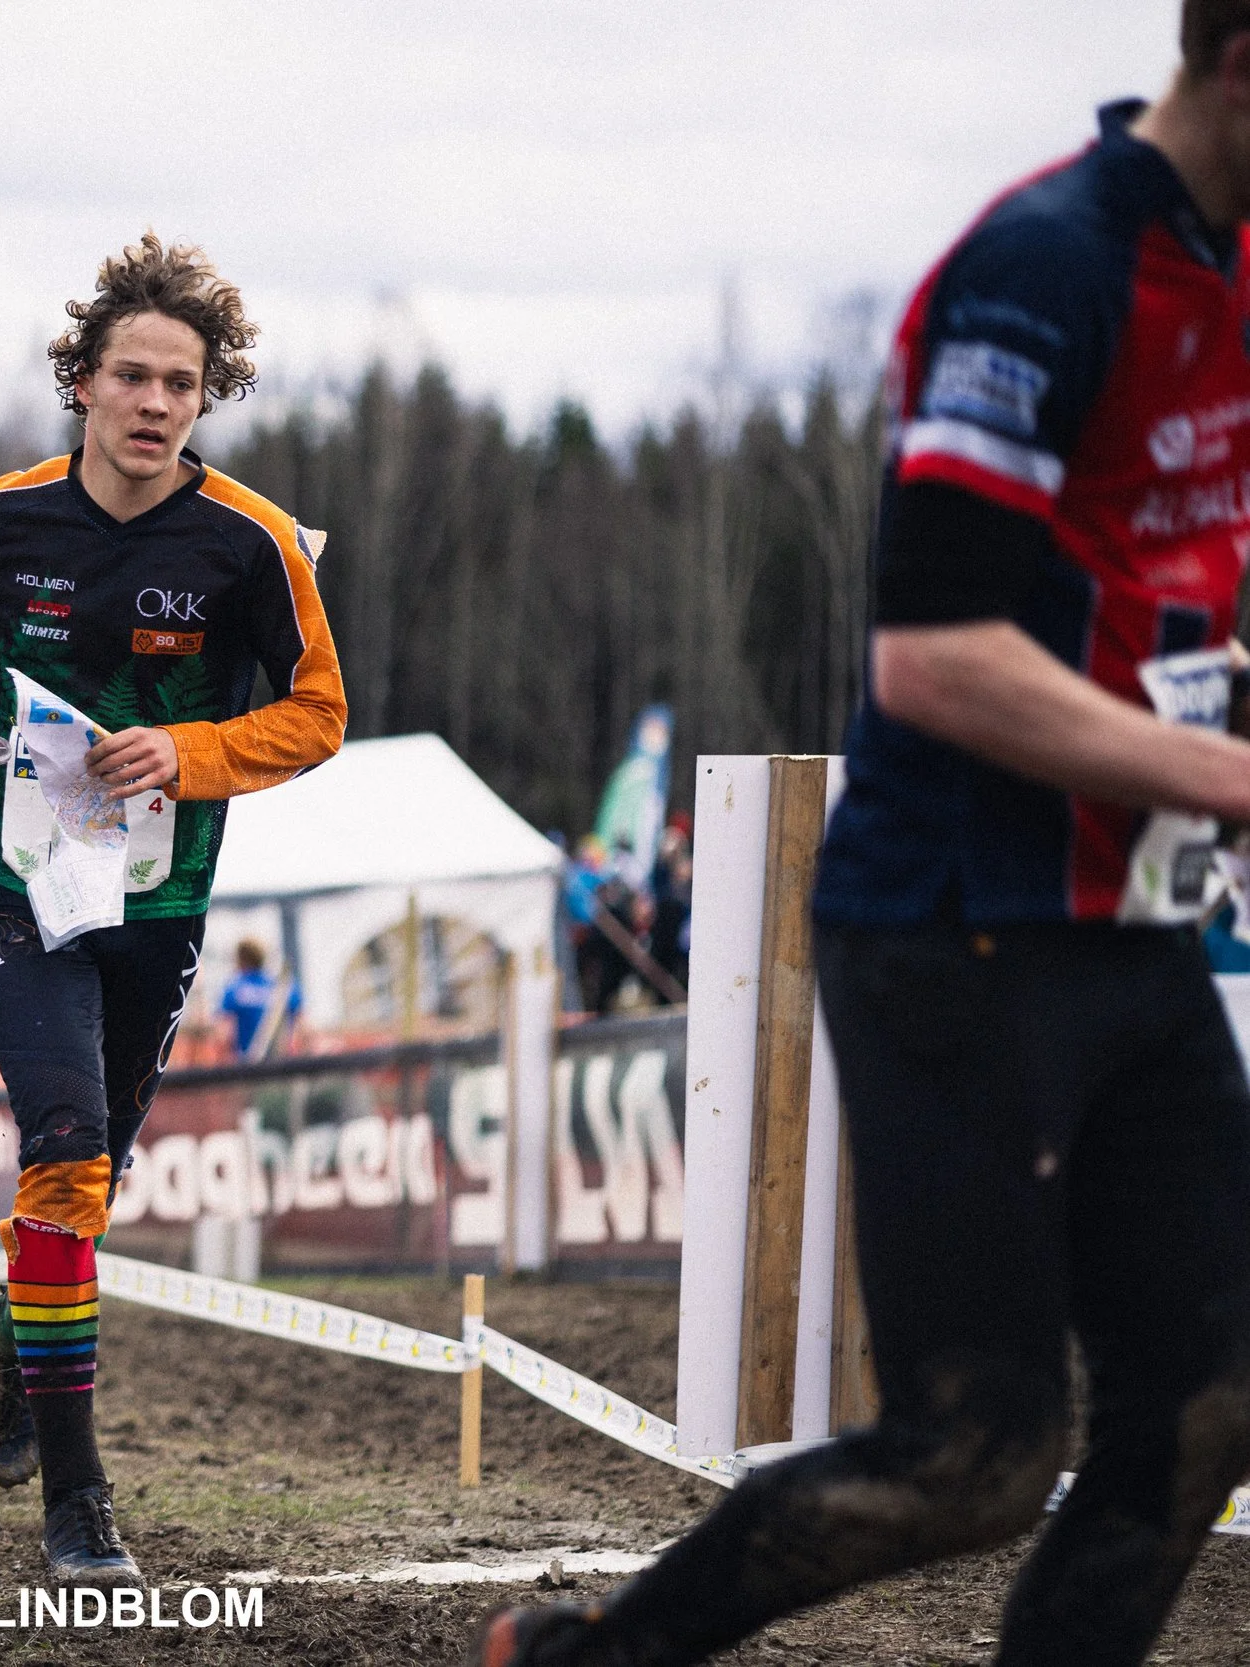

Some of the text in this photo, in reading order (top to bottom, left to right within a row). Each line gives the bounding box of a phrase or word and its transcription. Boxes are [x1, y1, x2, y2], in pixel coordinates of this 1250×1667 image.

[16, 573, 75, 592] HOLMEN
[26, 606, 69, 618] SPORT
[136, 587, 206, 621] OKK
[21, 623, 70, 641] TRIMTEX
[148, 796, 164, 815] 4
